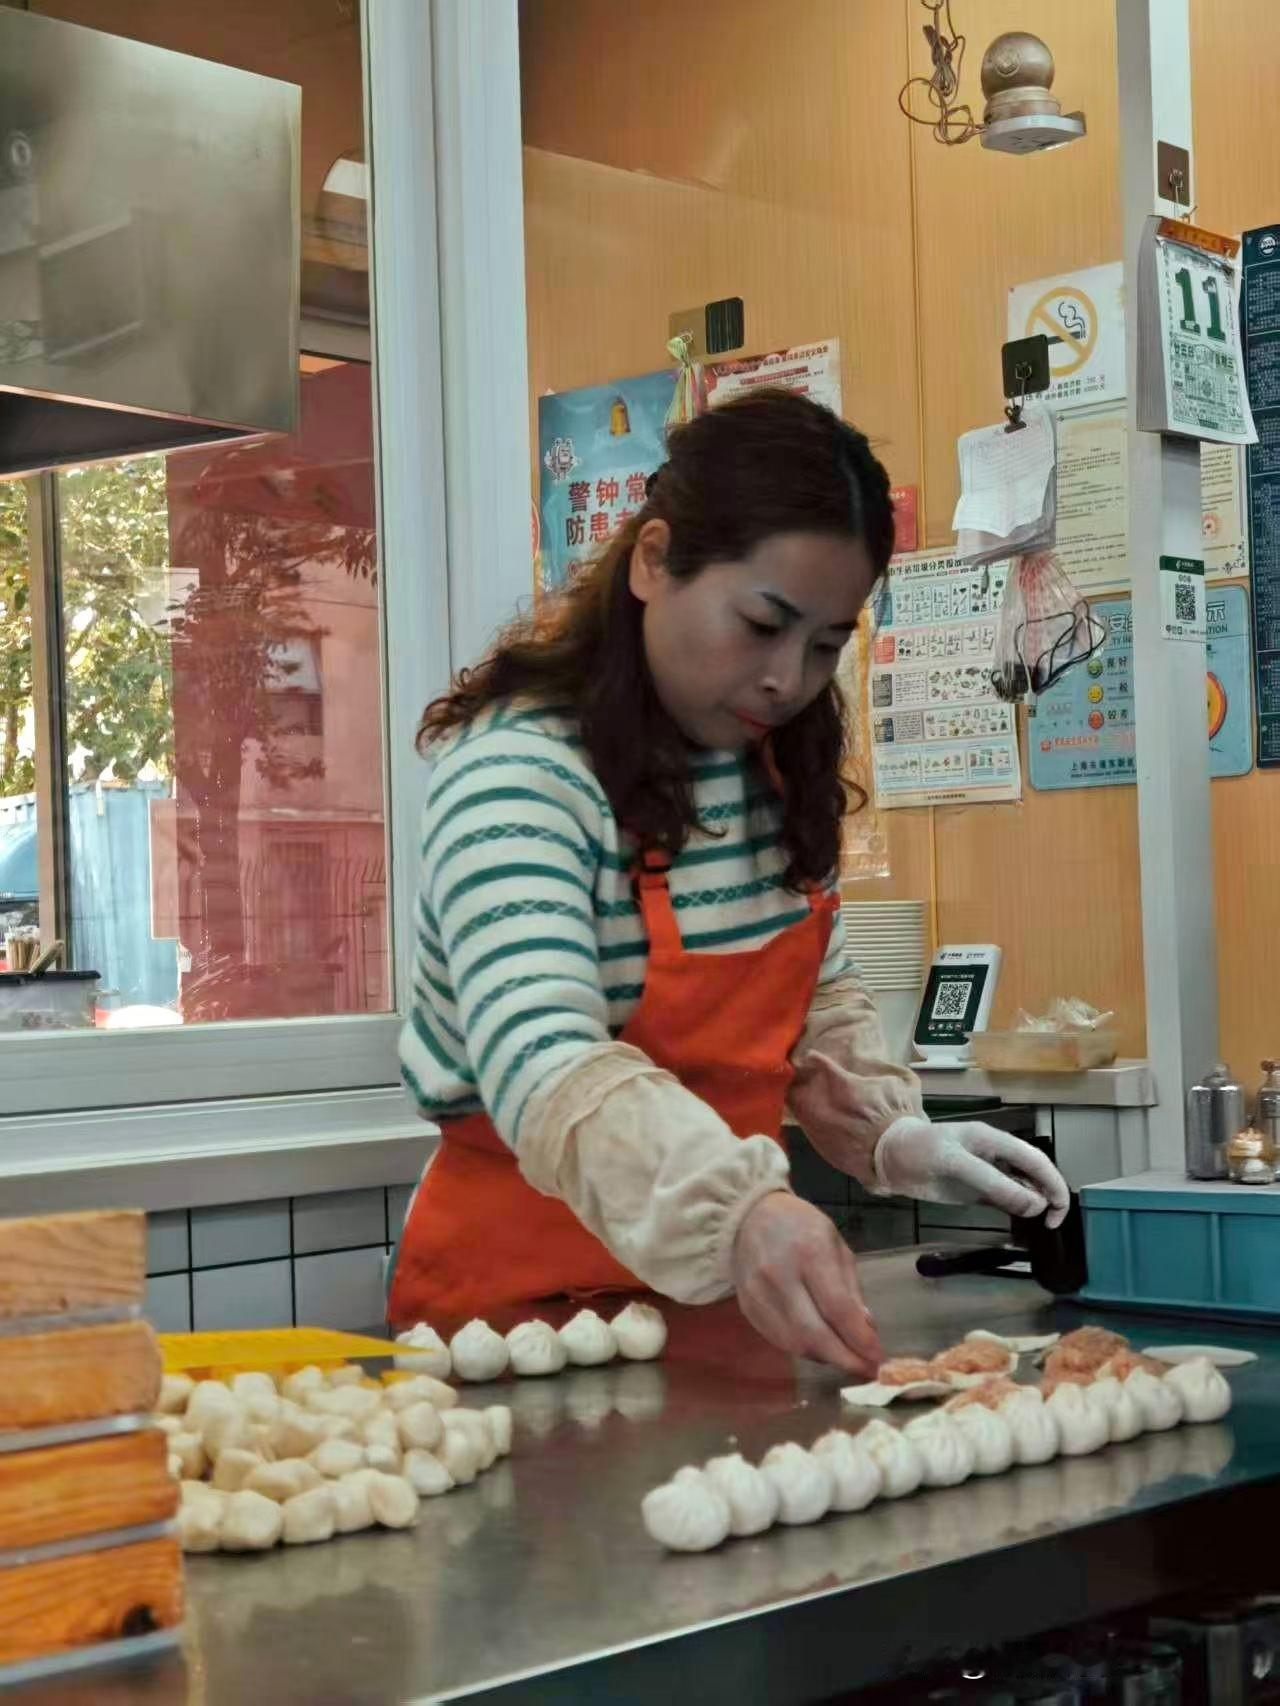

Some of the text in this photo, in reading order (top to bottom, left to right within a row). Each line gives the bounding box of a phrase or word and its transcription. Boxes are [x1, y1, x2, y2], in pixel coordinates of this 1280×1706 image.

[1175, 267, 1226, 343] 11
[568, 471, 647, 513] 警钟常
[1206, 600, 1225, 623] 示
